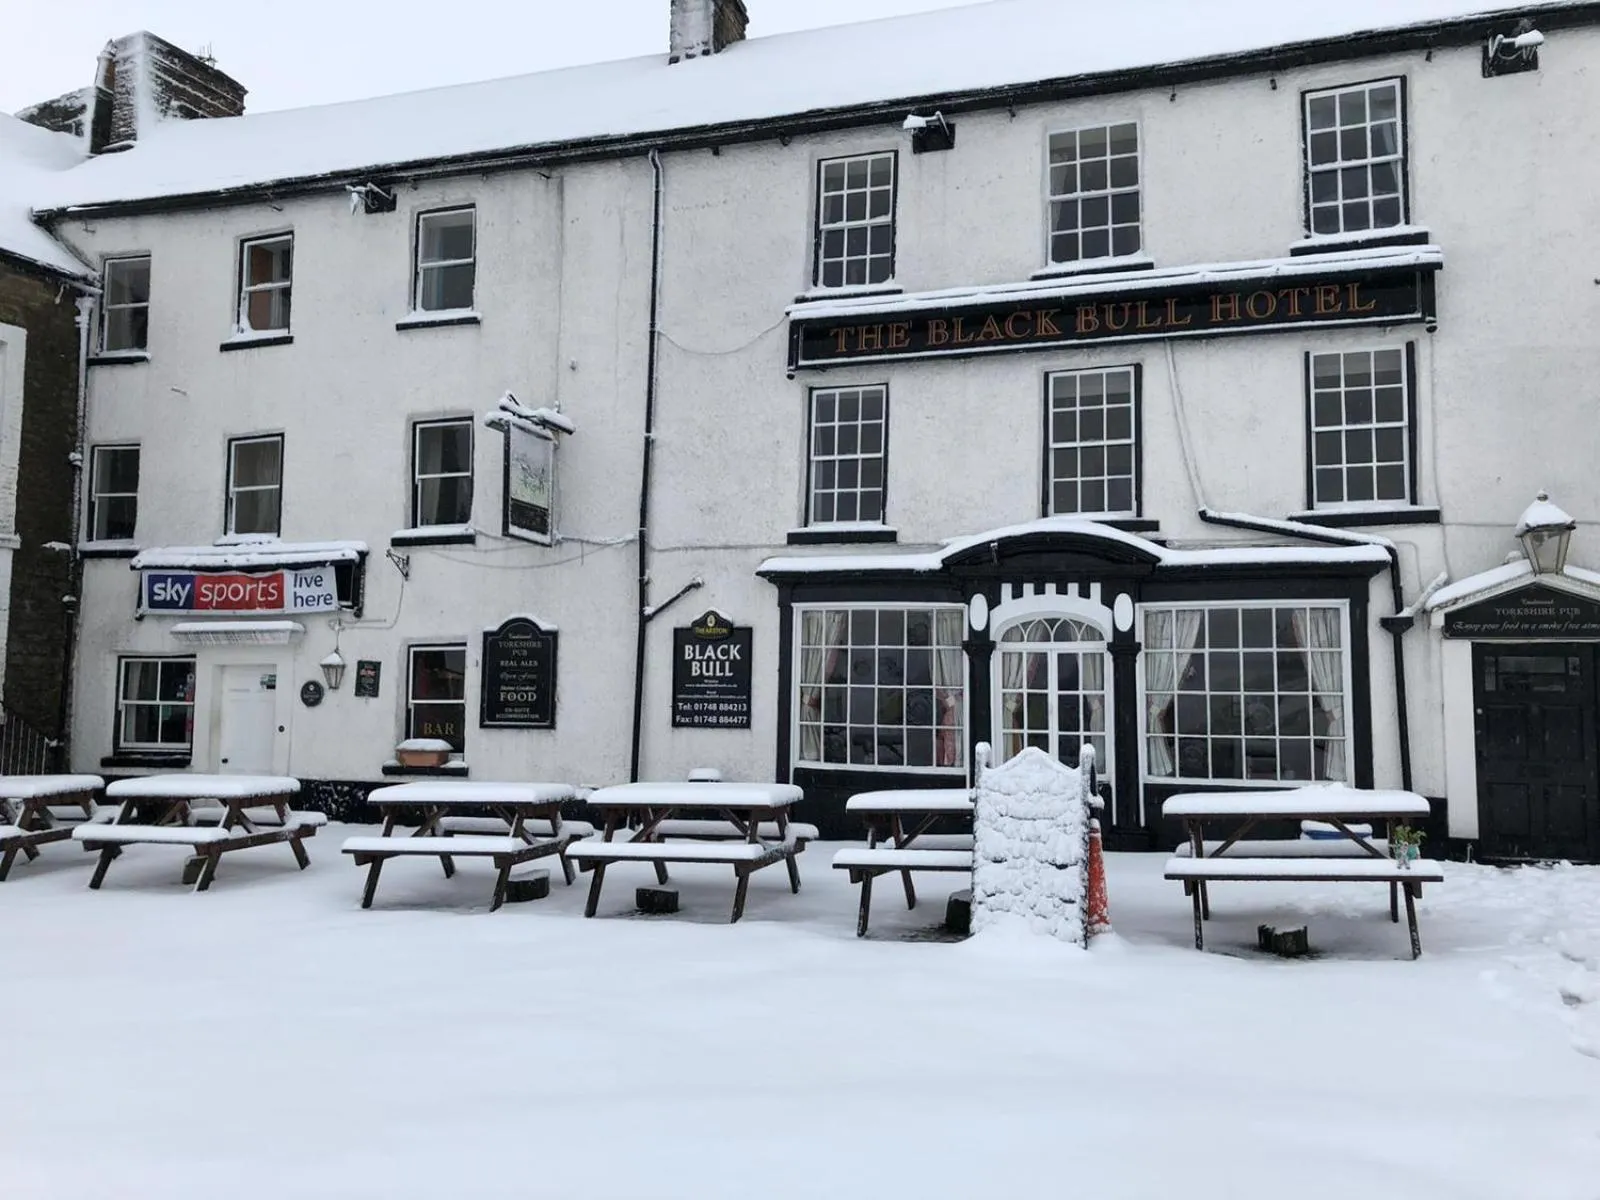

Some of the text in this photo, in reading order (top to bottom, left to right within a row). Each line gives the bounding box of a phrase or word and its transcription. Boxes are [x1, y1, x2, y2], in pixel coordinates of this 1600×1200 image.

[830, 282, 1377, 353] THE BLACK BULL HOTEL
[293, 573, 324, 587] live
[153, 577, 278, 607] sky sports
[293, 591, 333, 607] here
[1495, 607, 1581, 616] YORKSHIRE PUB
[498, 640, 543, 649] YORKSHIRE
[512, 649, 528, 657] PUB
[684, 644, 742, 660] BLACK
[520, 660, 539, 668] ALES
[691, 661, 734, 677] BULL
[500, 691, 537, 702] FOOD
[676, 715, 692, 723] Fax:
[423, 722, 455, 736] BAR
